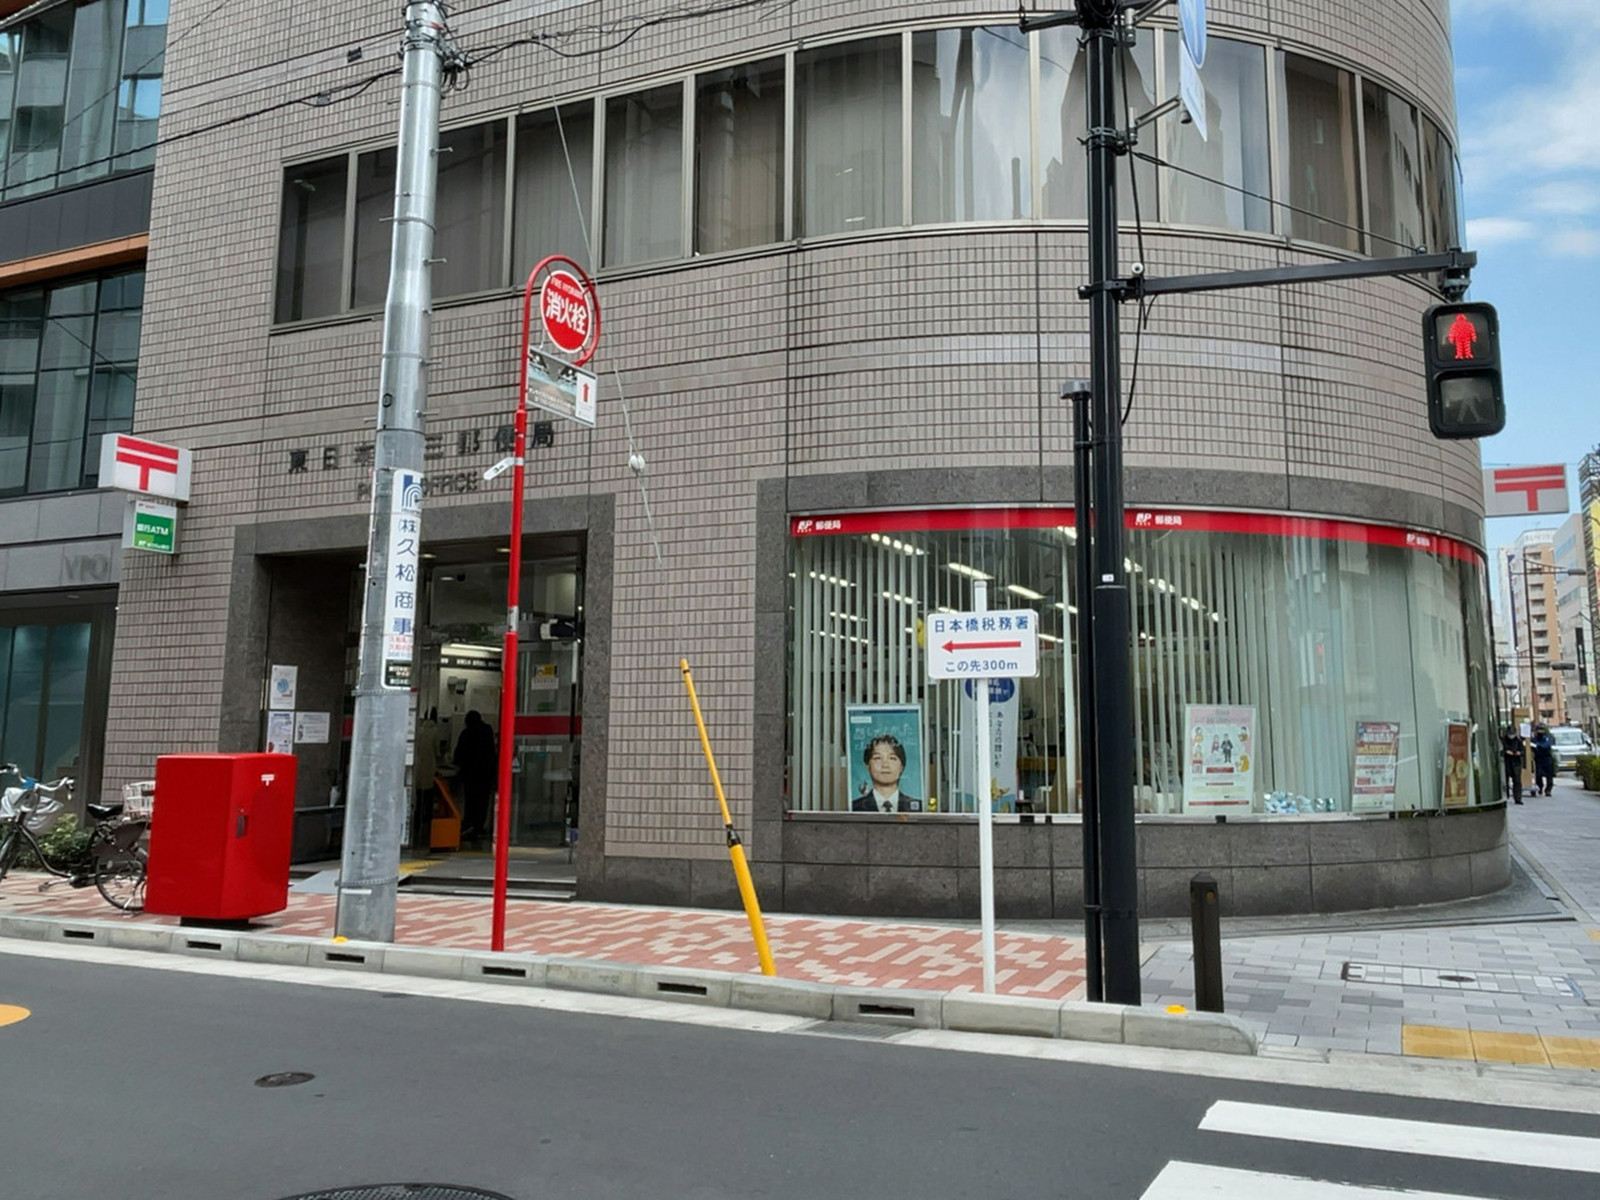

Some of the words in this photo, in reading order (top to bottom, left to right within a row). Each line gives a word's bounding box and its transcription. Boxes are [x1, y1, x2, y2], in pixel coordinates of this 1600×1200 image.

[546, 288, 587, 336] 消火栓
[934, 615, 1029, 633] 日本橋税務署
[945, 659, 1018, 672] この先300m
